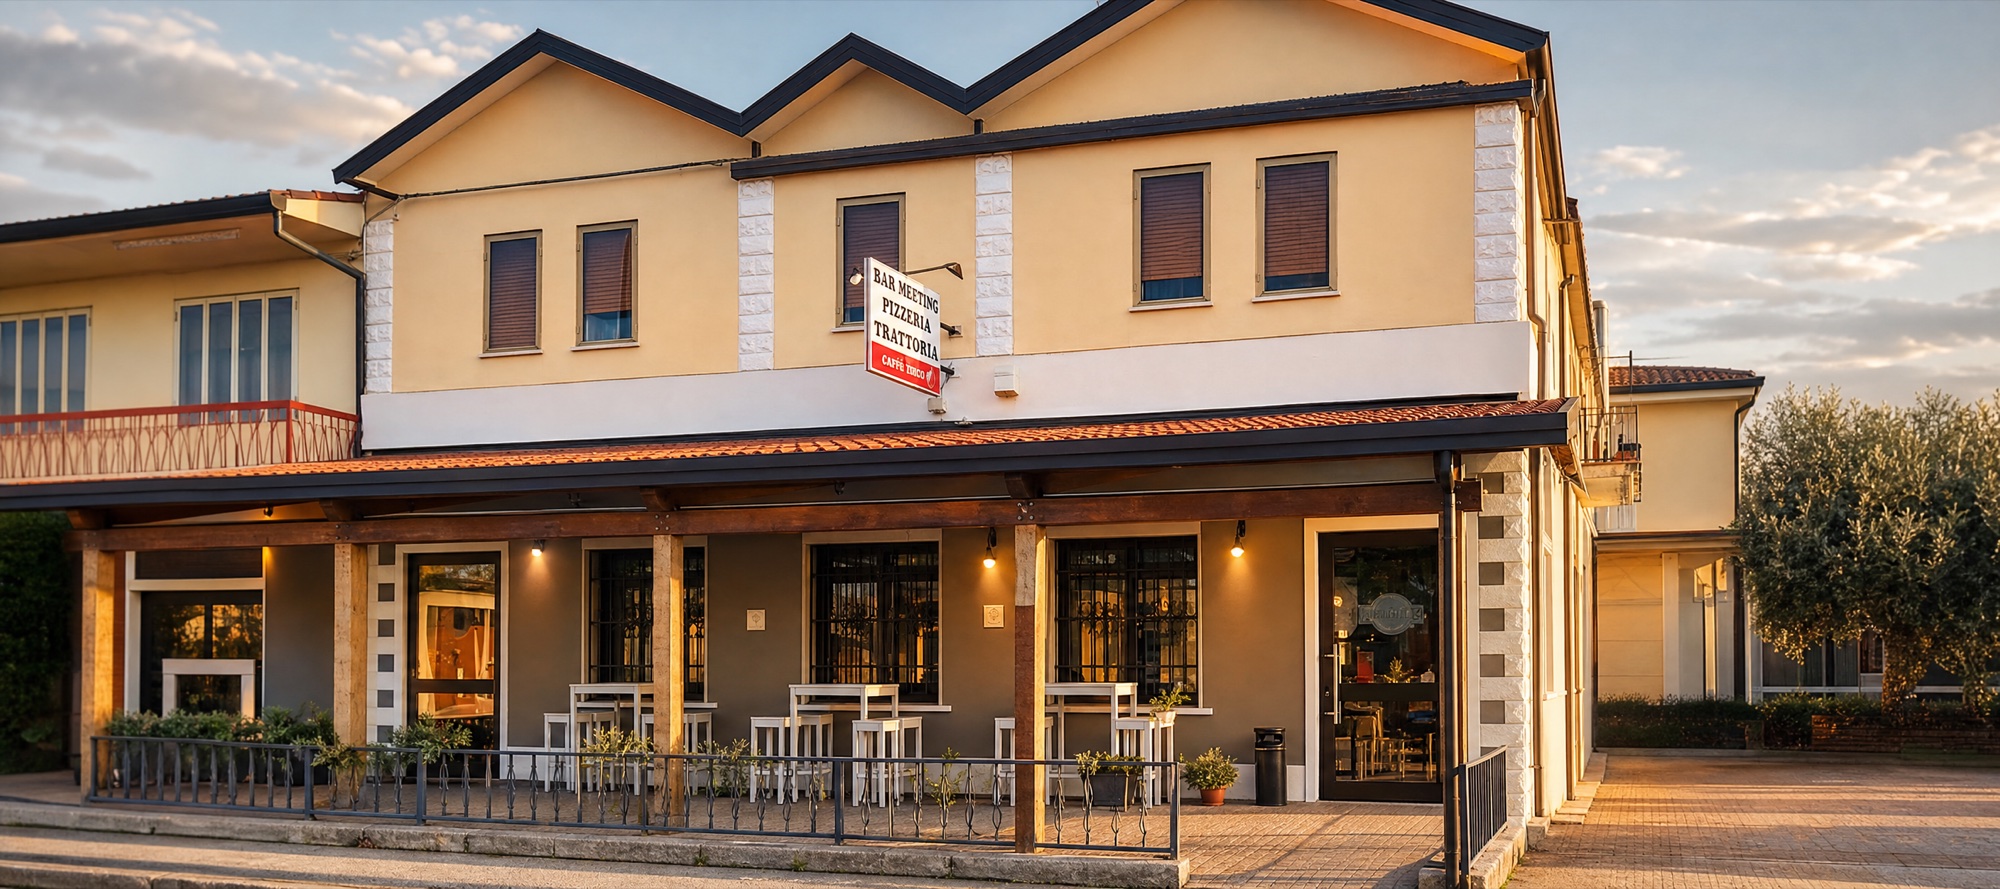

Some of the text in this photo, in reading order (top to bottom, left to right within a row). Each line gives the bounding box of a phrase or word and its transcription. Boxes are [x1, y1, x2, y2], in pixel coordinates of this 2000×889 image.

[873, 267, 939, 314] BAR MEETING
[882, 297, 931, 334] PIZZERIA
[874, 320, 938, 361] TRATTORIA
